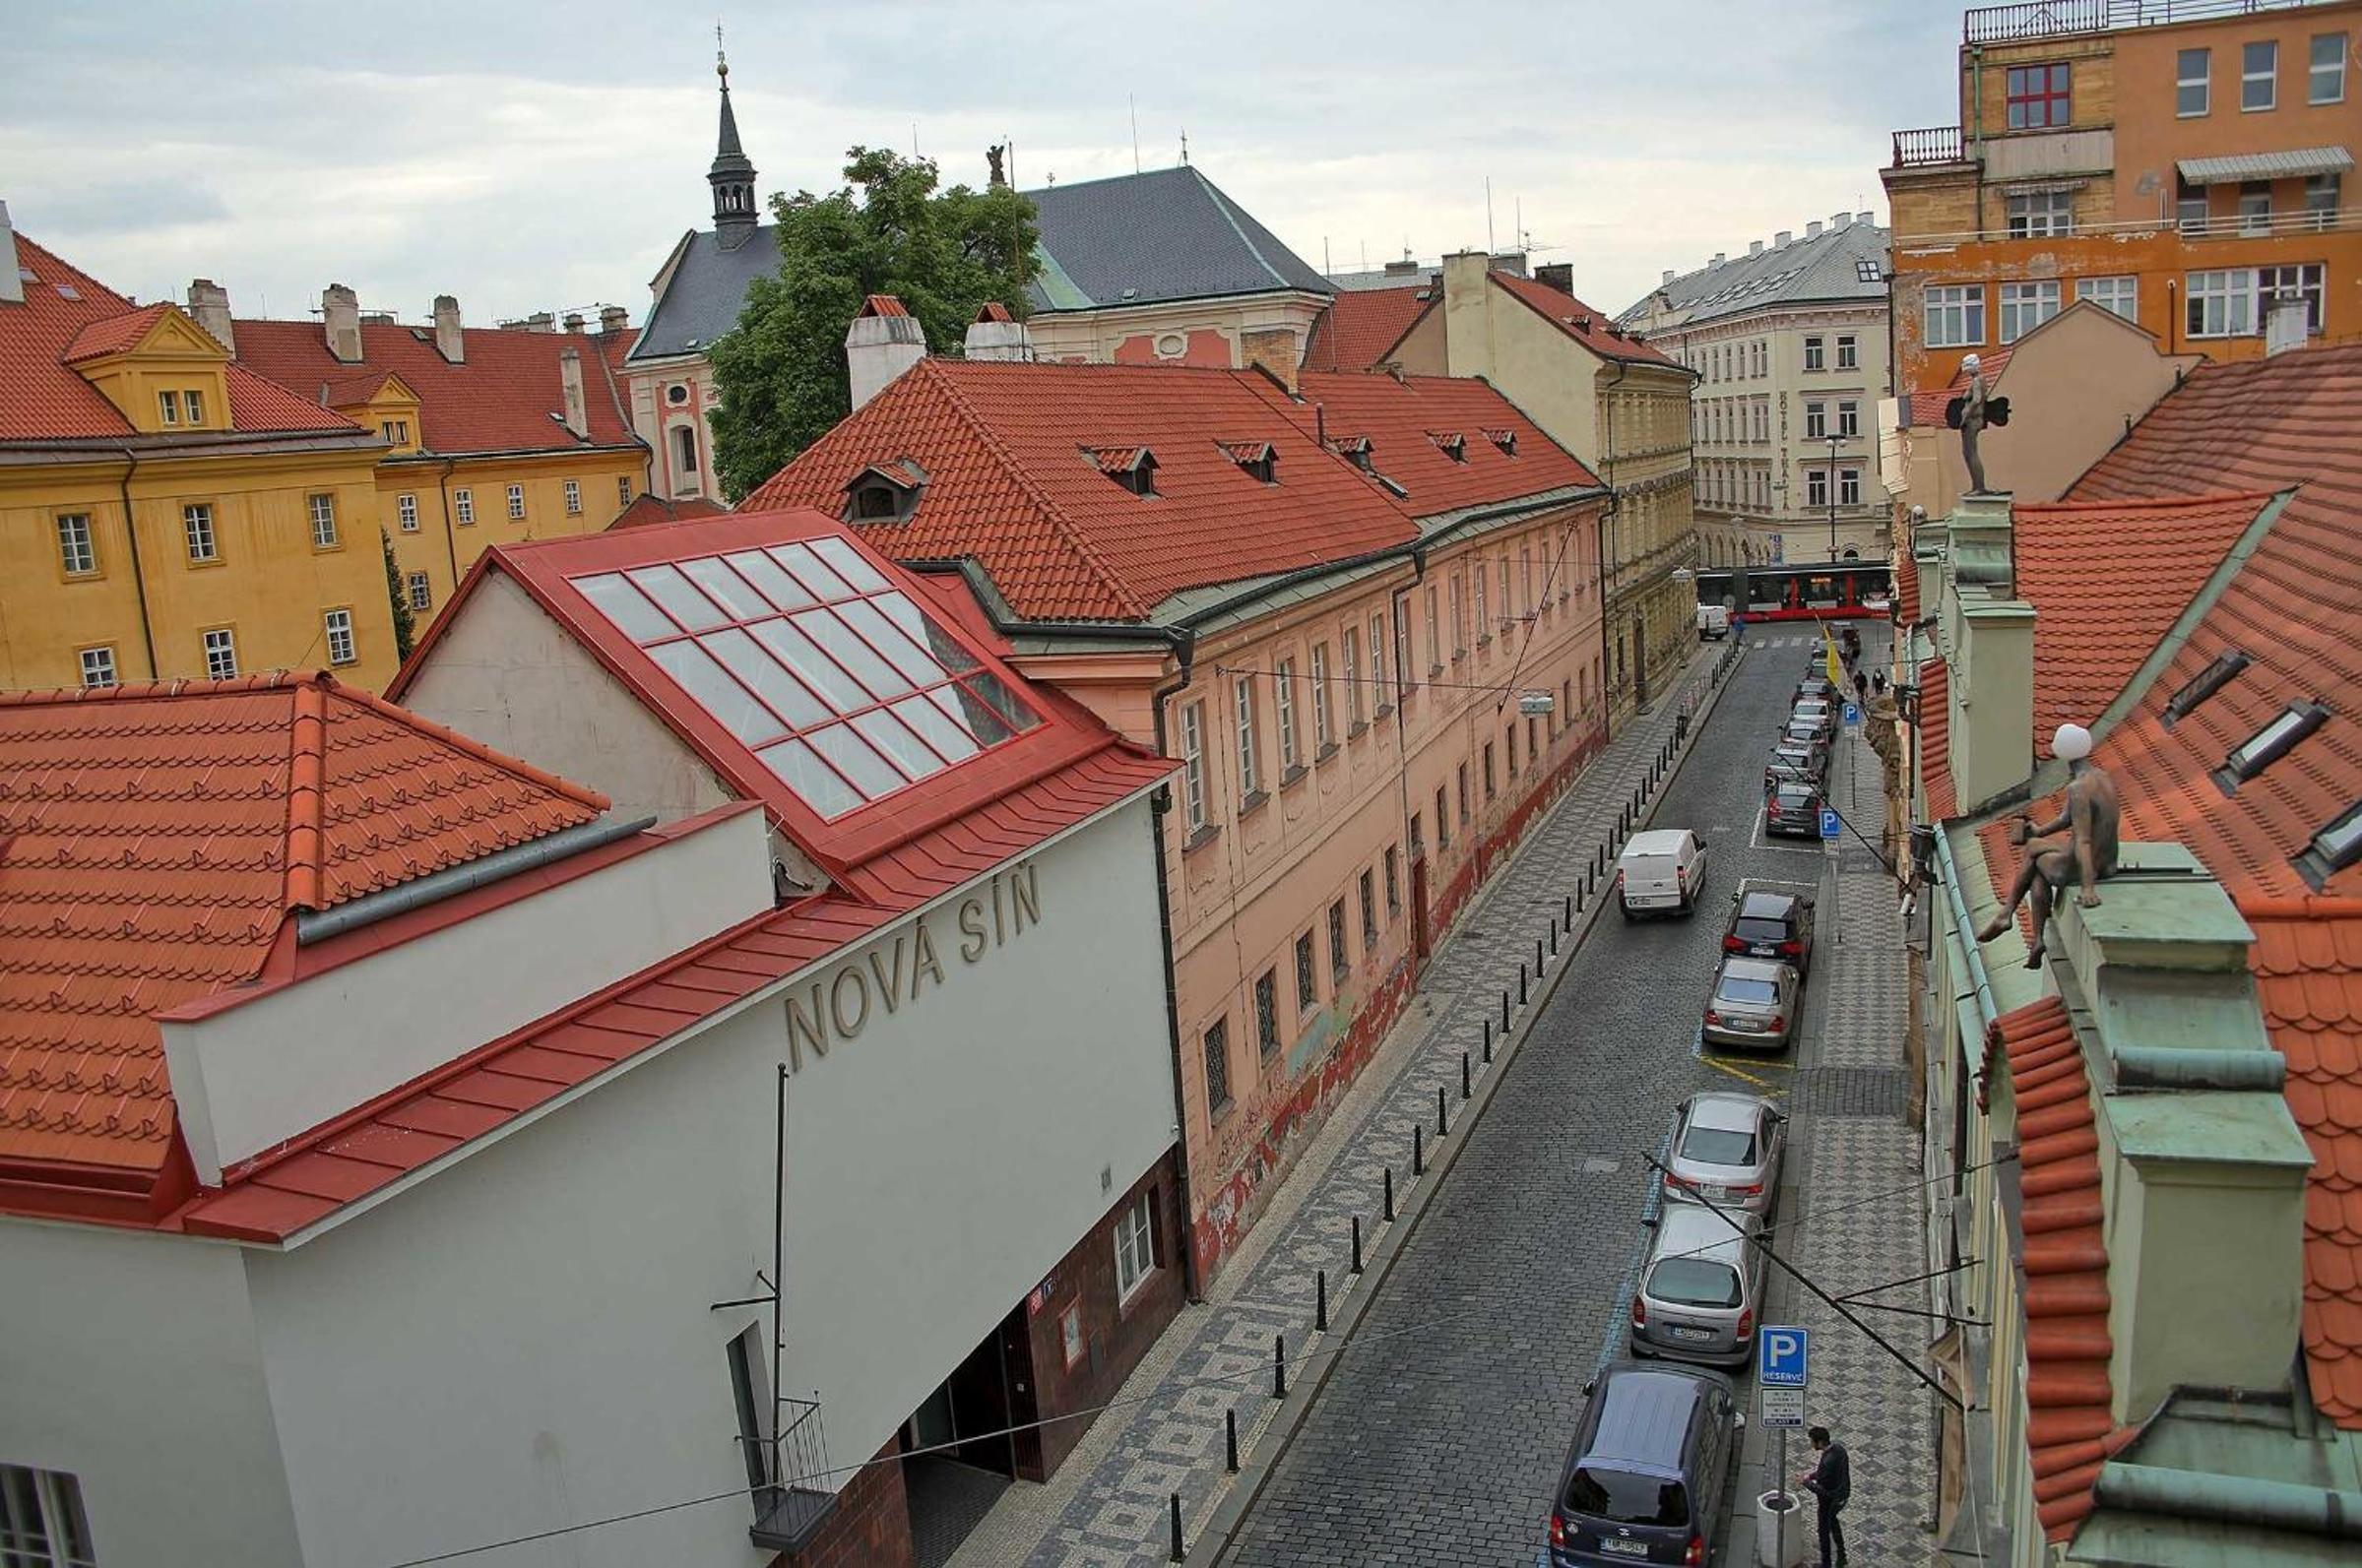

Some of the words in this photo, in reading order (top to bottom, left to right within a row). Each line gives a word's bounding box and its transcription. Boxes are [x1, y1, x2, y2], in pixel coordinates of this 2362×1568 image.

[1779, 391, 1788, 442] HOTEL
[1846, 706, 1856, 719] P
[1823, 812, 1835, 829] P
[785, 913, 945, 1073] NOVÁ
[1770, 1335, 1797, 1367] P
